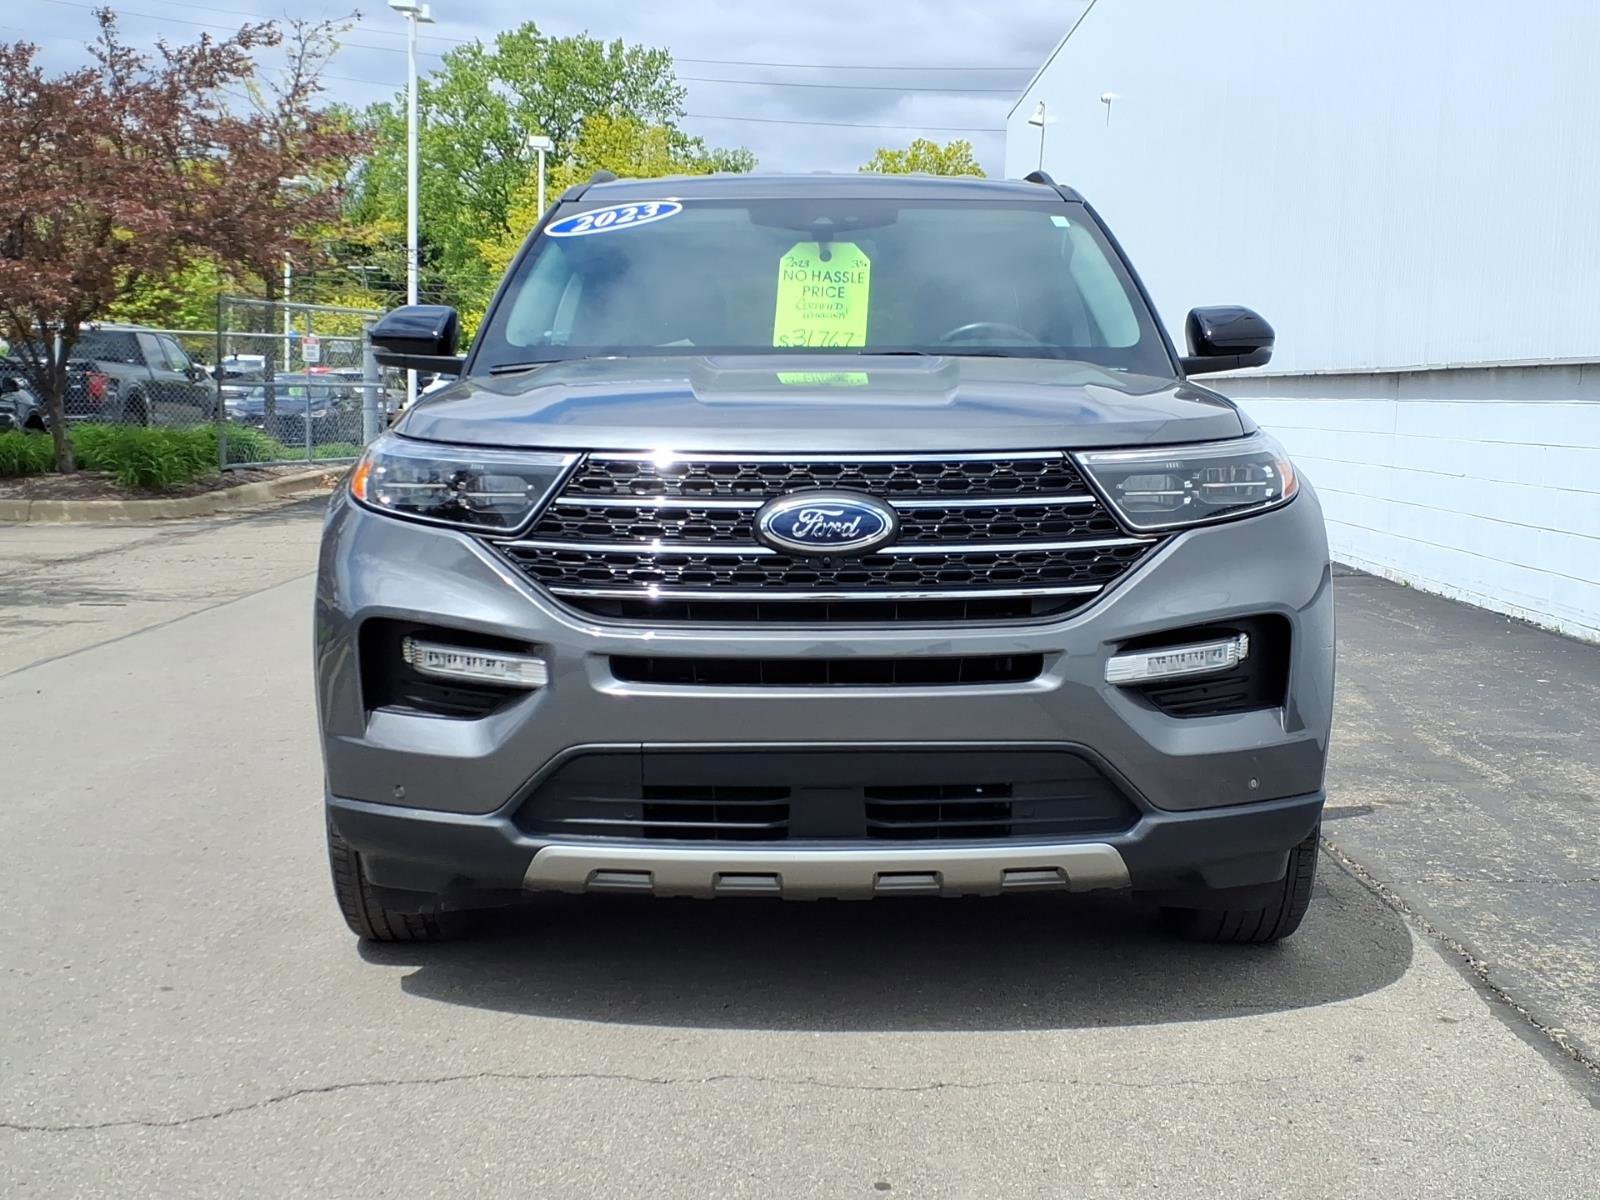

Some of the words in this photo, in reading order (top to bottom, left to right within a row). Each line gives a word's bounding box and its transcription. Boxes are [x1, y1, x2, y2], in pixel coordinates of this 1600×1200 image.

[570, 203, 660, 232] 2023
[783, 269, 807, 281] NO
[812, 270, 865, 284] HASSLE
[802, 285, 846, 299] PRICE
[792, 508, 862, 537] Ford
